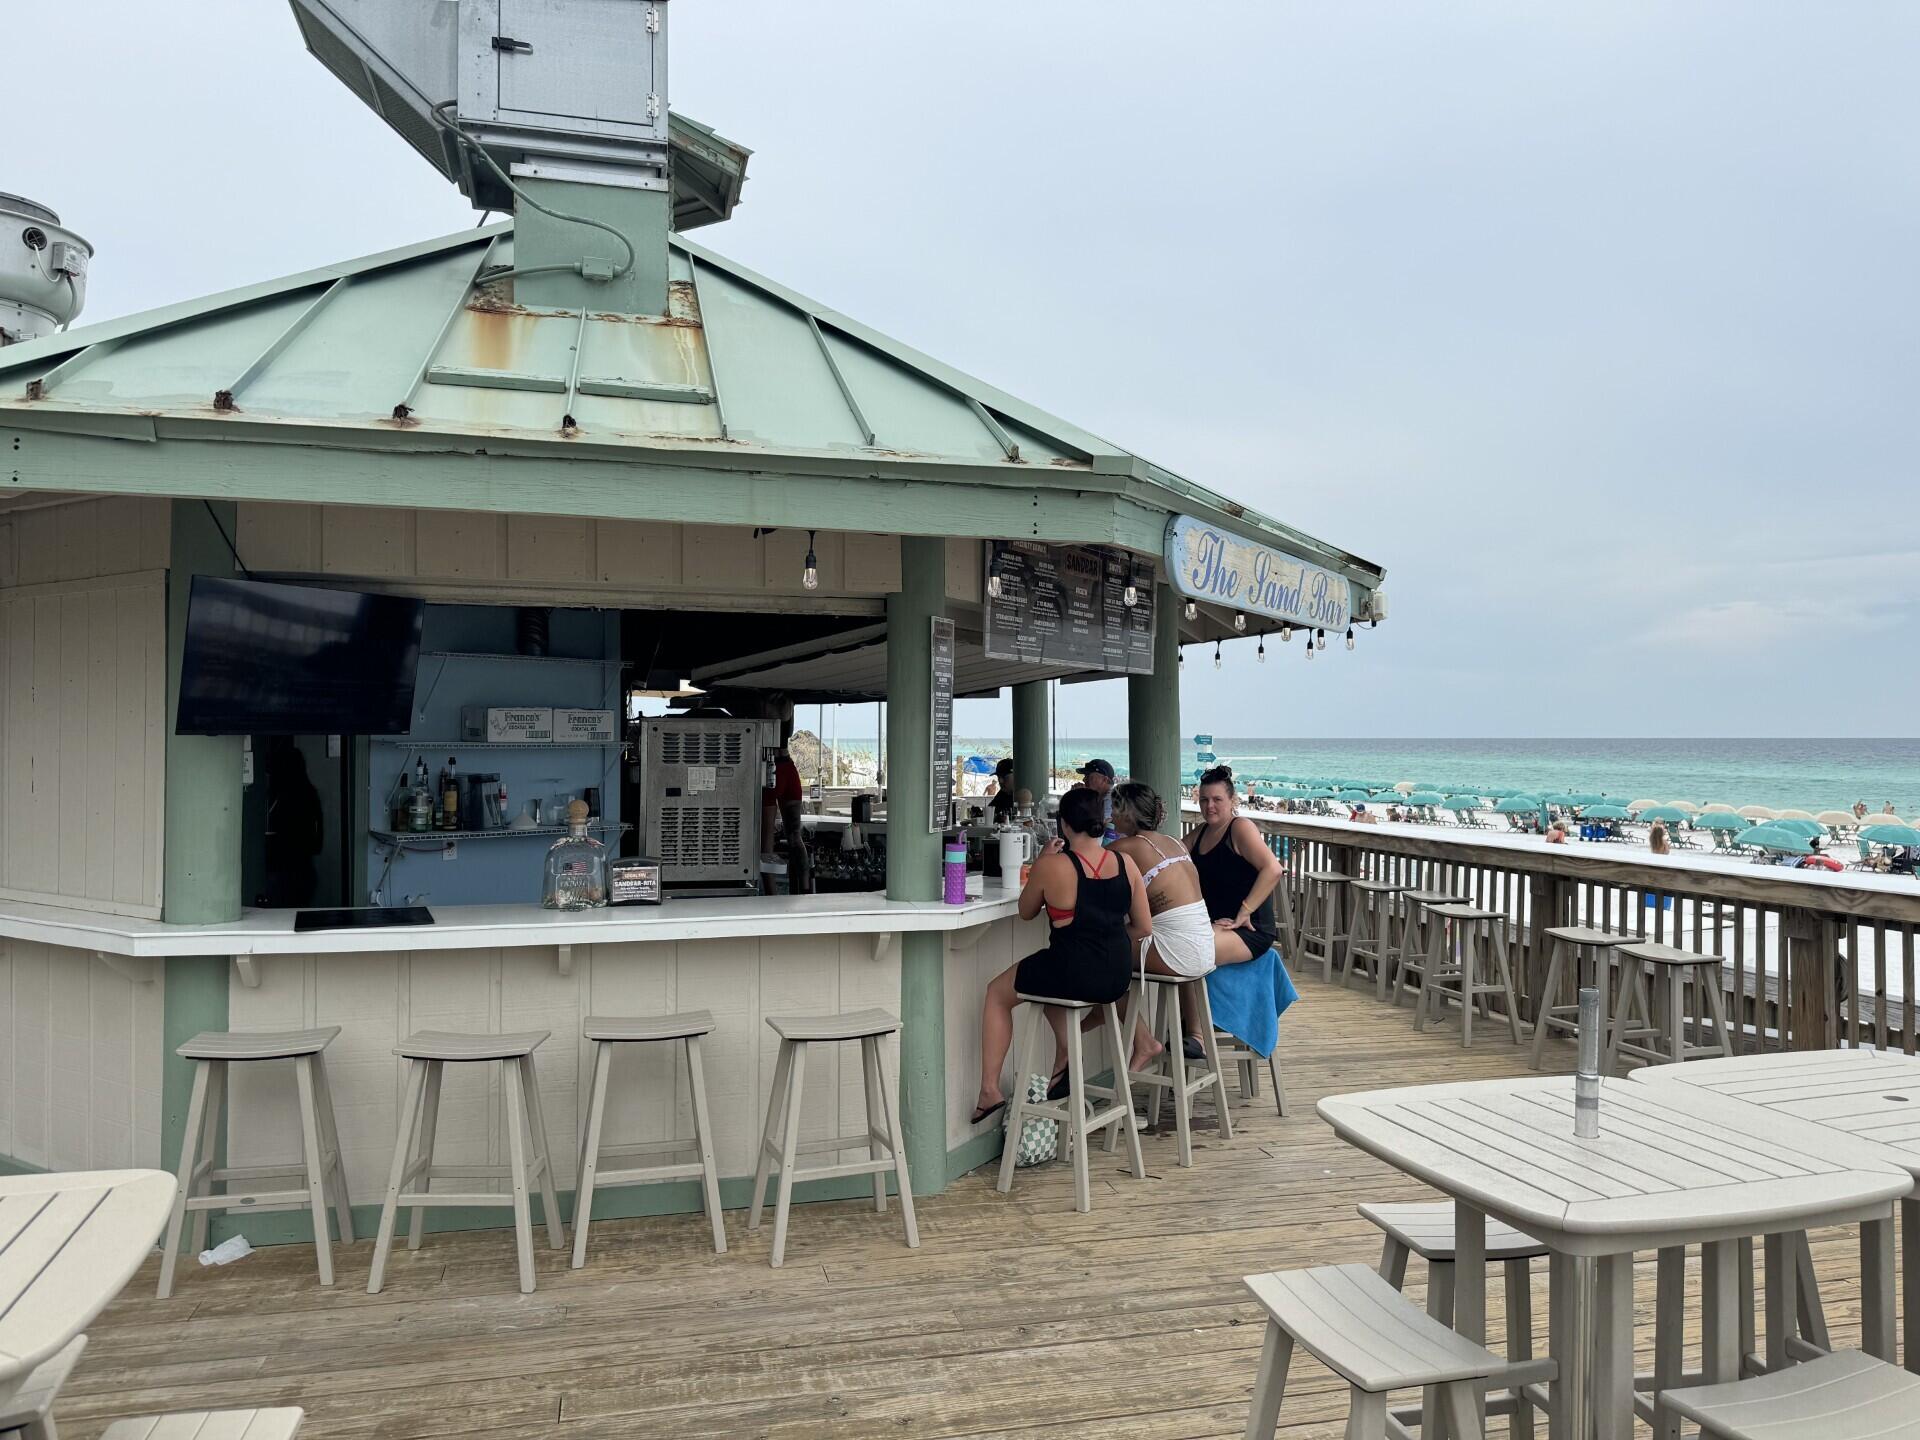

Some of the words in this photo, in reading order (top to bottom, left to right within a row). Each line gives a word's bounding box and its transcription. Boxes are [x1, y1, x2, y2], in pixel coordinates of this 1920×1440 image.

[1066, 551, 1098, 577] SANDBAR
[1192, 530, 1242, 598] The
[1248, 551, 1305, 616] Sand
[1309, 571, 1347, 626] Bar
[505, 711, 541, 722] Franco's
